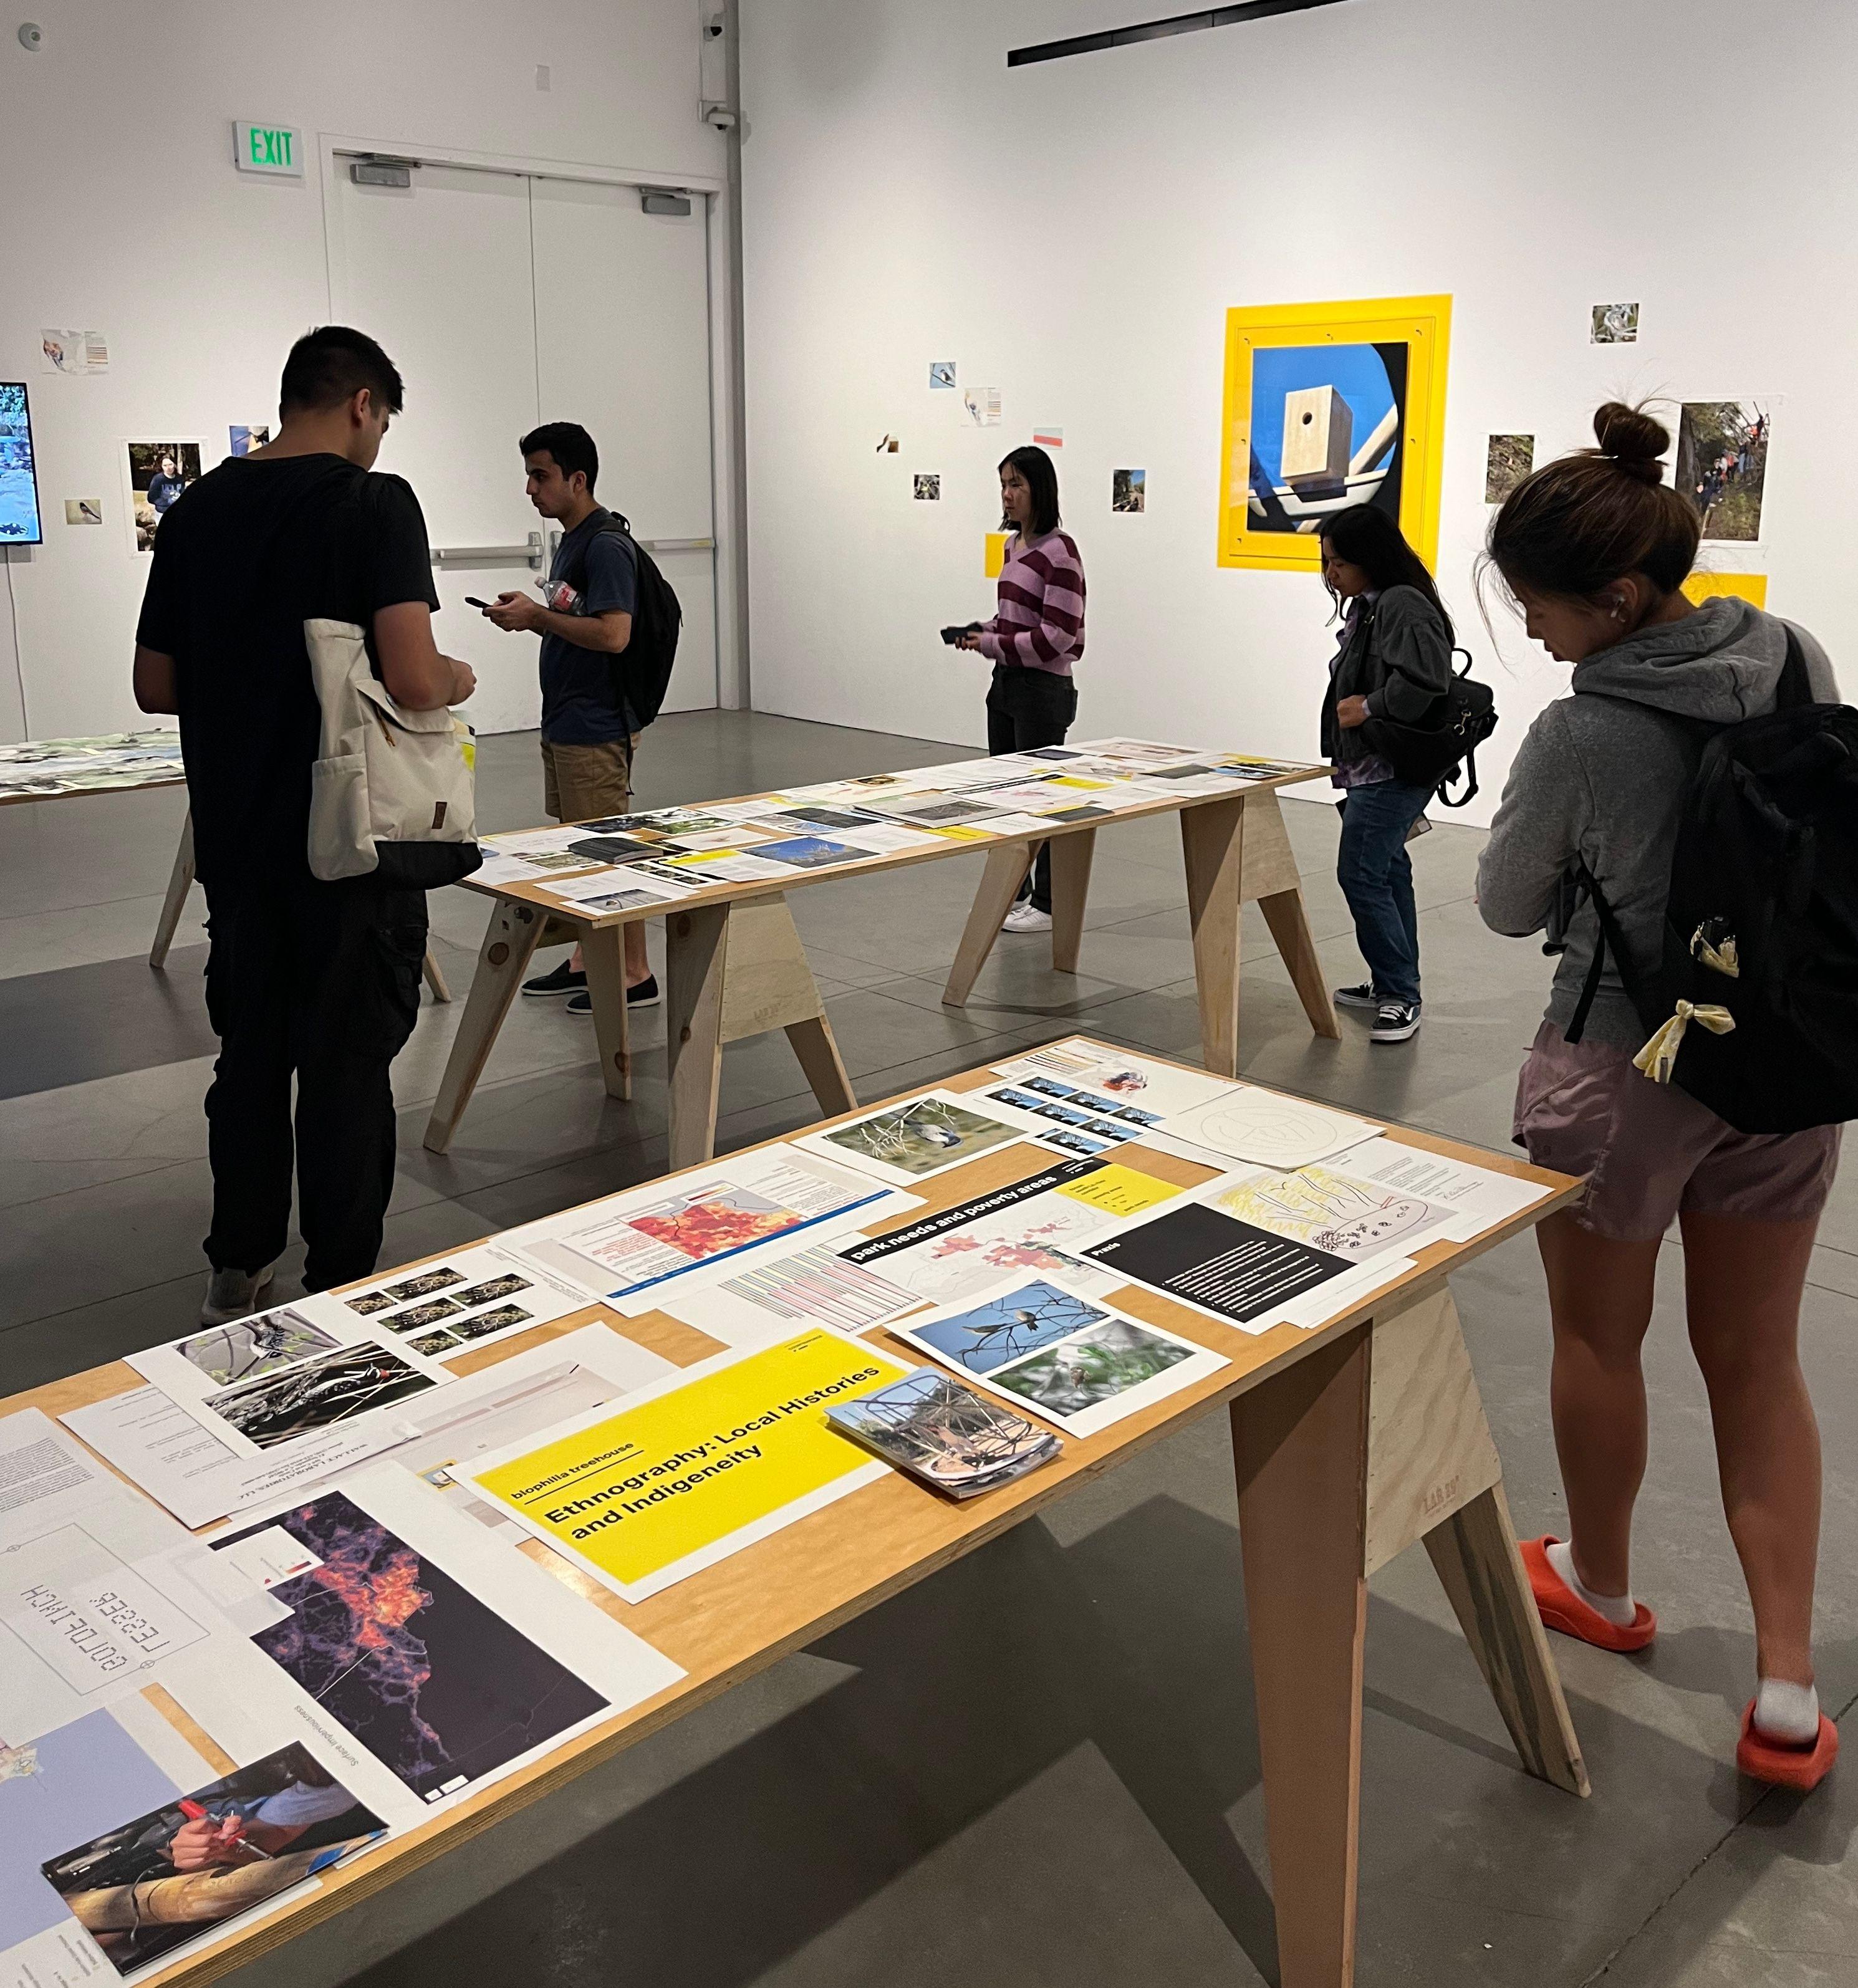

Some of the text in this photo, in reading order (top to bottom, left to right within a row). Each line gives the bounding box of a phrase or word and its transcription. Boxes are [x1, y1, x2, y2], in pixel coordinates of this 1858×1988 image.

[251, 128, 292, 166] EXIT
[850, 1240, 892, 1261] park
[888, 1224, 938, 1246] needs
[935, 1211, 966, 1227] and
[963, 1189, 1019, 1217] poverty
[1016, 1176, 1057, 1194] areas
[1090, 1242, 1121, 1256] Praxis
[544, 1366, 880, 1524] Ethnography: Local Histories
[569, 1443, 633, 1474] treehouse
[572, 1444, 762, 1539] and Indigeneity
[20, 1584, 128, 1671] GOLDFINCH
[89, 1592, 170, 1653] LESSER
[335, 1745, 359, 1767] Surface
